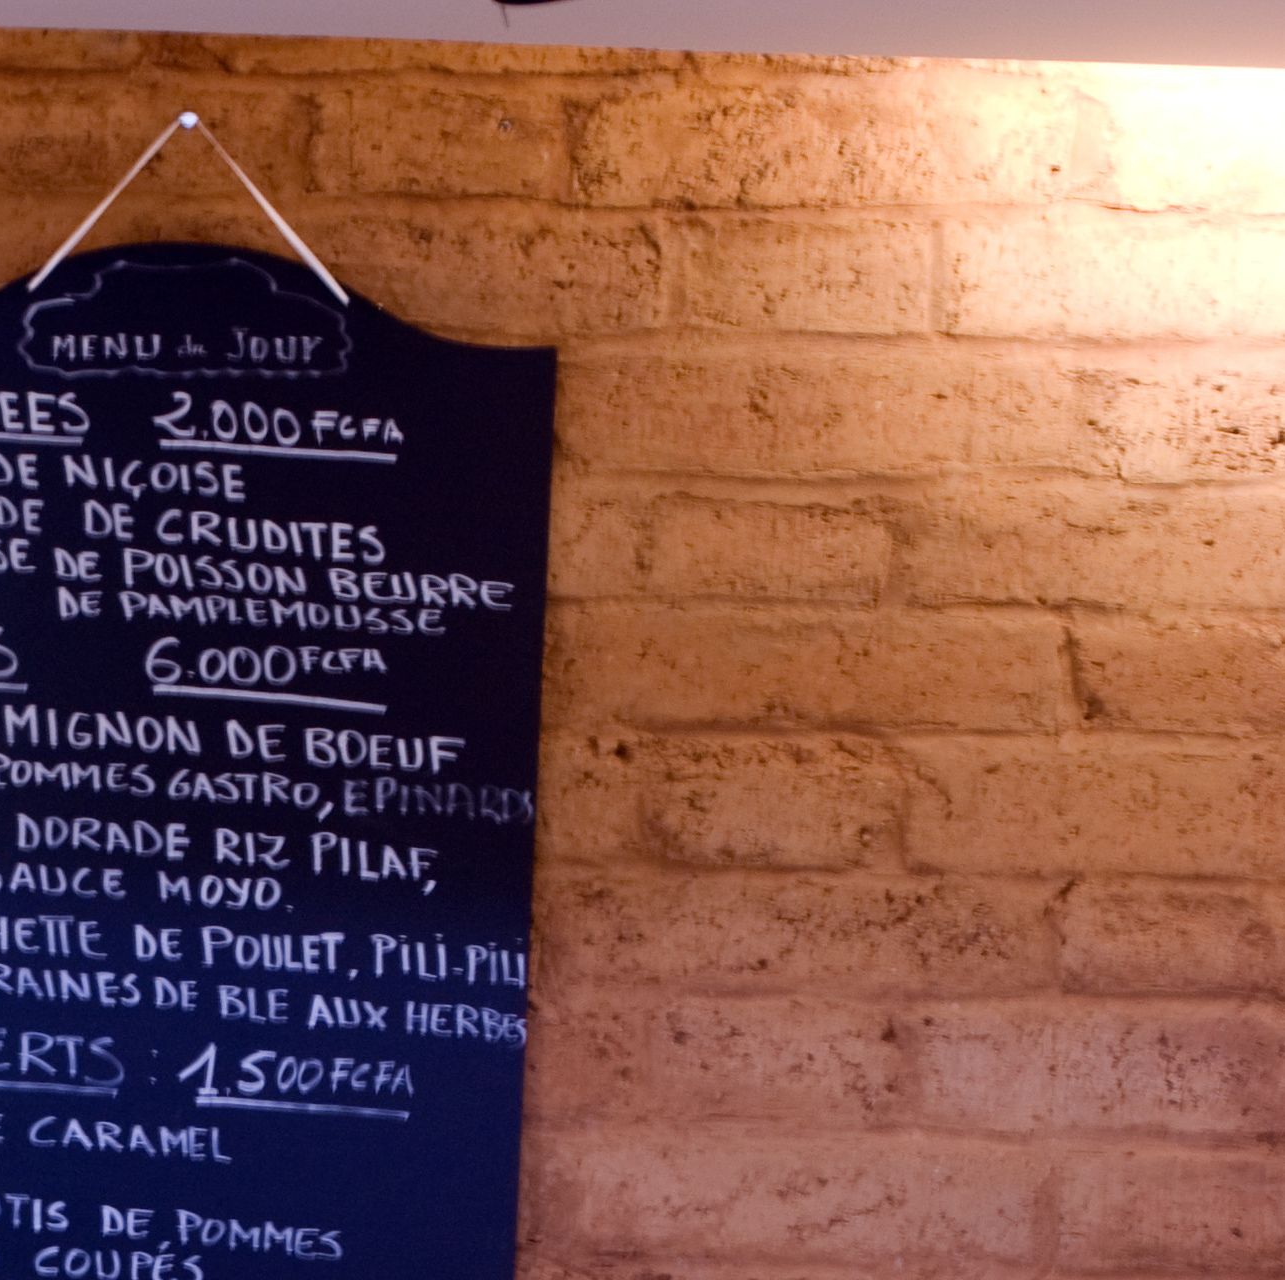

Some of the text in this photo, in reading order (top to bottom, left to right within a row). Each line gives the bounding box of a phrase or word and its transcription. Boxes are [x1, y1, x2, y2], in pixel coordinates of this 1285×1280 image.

[52, 332, 161, 361] MENU
[178, 335, 208, 357] du
[62, 454, 246, 501] NIÇOISE
[84, 500, 134, 541] DE
[156, 508, 386, 564] CRUDITES
[54, 547, 103, 581] DE
[123, 548, 307, 596] POISSON
[328, 567, 514, 610] BEURRE
[57, 586, 446, 635] DE PAMPLEMOUSSE
[3, 704, 201, 756] MIGNON
[226, 719, 286, 762] DE
[305, 727, 466, 774] BOEUF
[167, 768, 334, 822] GASTRO,
[16, 812, 190, 860] DORADE
[215, 828, 290, 869] RIZ
[310, 832, 439, 897] PILAF,
[134, 925, 182, 962] DE
[200, 926, 359, 981] POULET,
[153, 976, 198, 1012] DE
[219, 984, 290, 1024] BLE
[308, 994, 389, 1032] AUX
[406, 1000, 527, 1047] HERBES
[28, 1115, 232, 1164] CARAMEL
[102, 1204, 155, 1240] DE
[175, 1208, 343, 1261] POMMES
